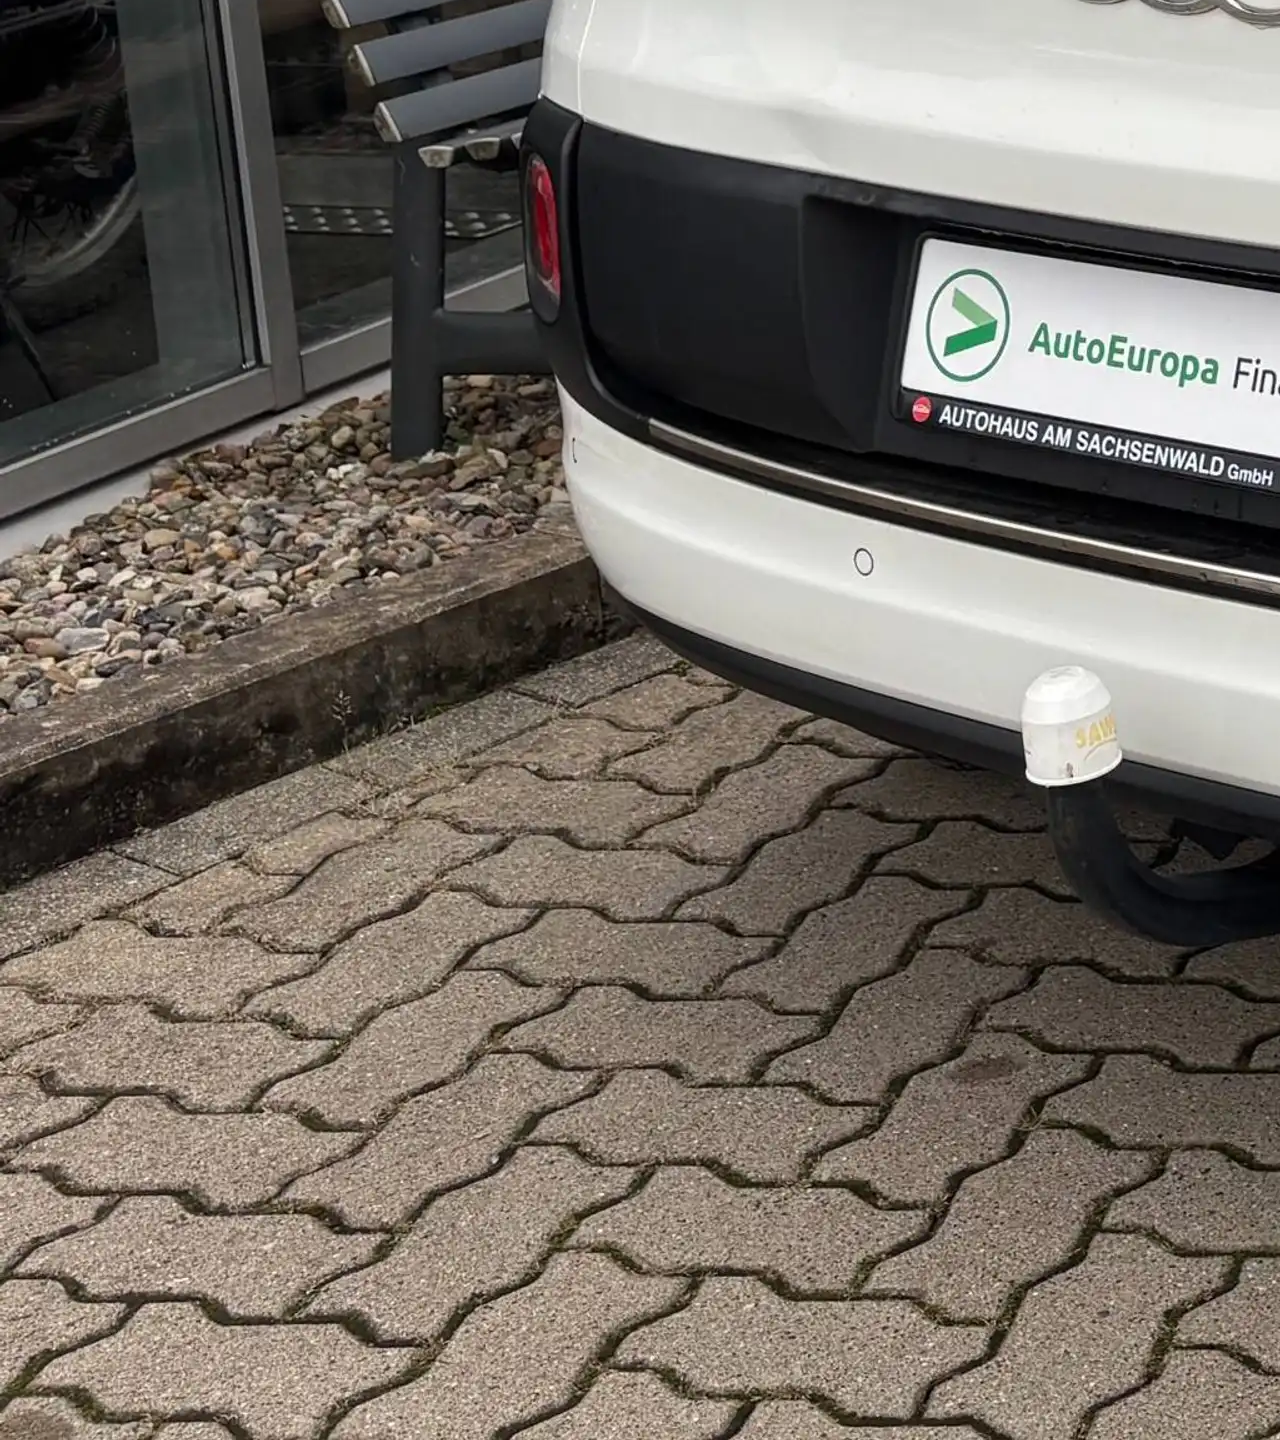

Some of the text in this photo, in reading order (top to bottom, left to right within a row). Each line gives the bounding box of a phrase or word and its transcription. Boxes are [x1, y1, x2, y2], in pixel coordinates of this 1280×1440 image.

[1027, 321, 1219, 388] AutoEuropa
[938, 404, 1039, 442] AUTOHAUS
[1041, 424, 1072, 448] AM
[1075, 431, 1225, 477] SACHSENWALD
[1226, 463, 1275, 487] GmbH
